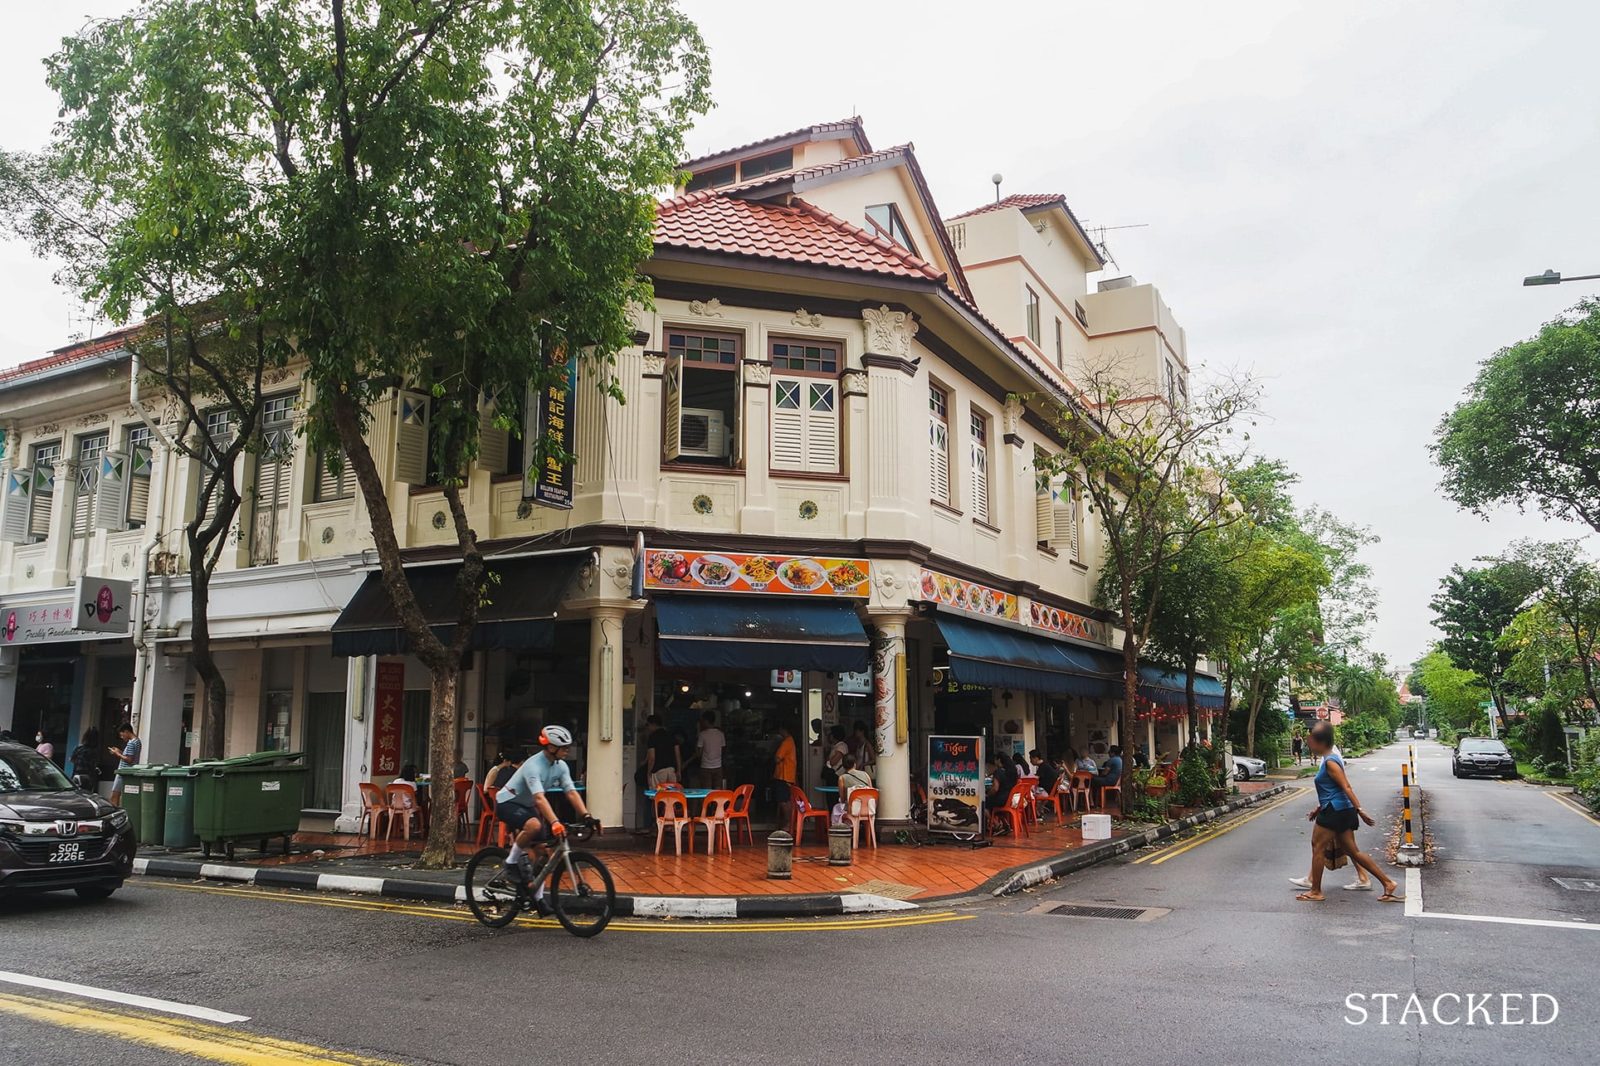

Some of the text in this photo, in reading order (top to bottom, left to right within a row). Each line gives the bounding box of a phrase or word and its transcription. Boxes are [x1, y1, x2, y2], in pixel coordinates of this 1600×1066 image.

[25, 629, 46, 640] Freshly
[944, 742, 968, 756] Tiger
[933, 787, 976, 796] 6366 9985
[58, 843, 79, 852] SGQ
[49, 851, 85, 862] 2226E
